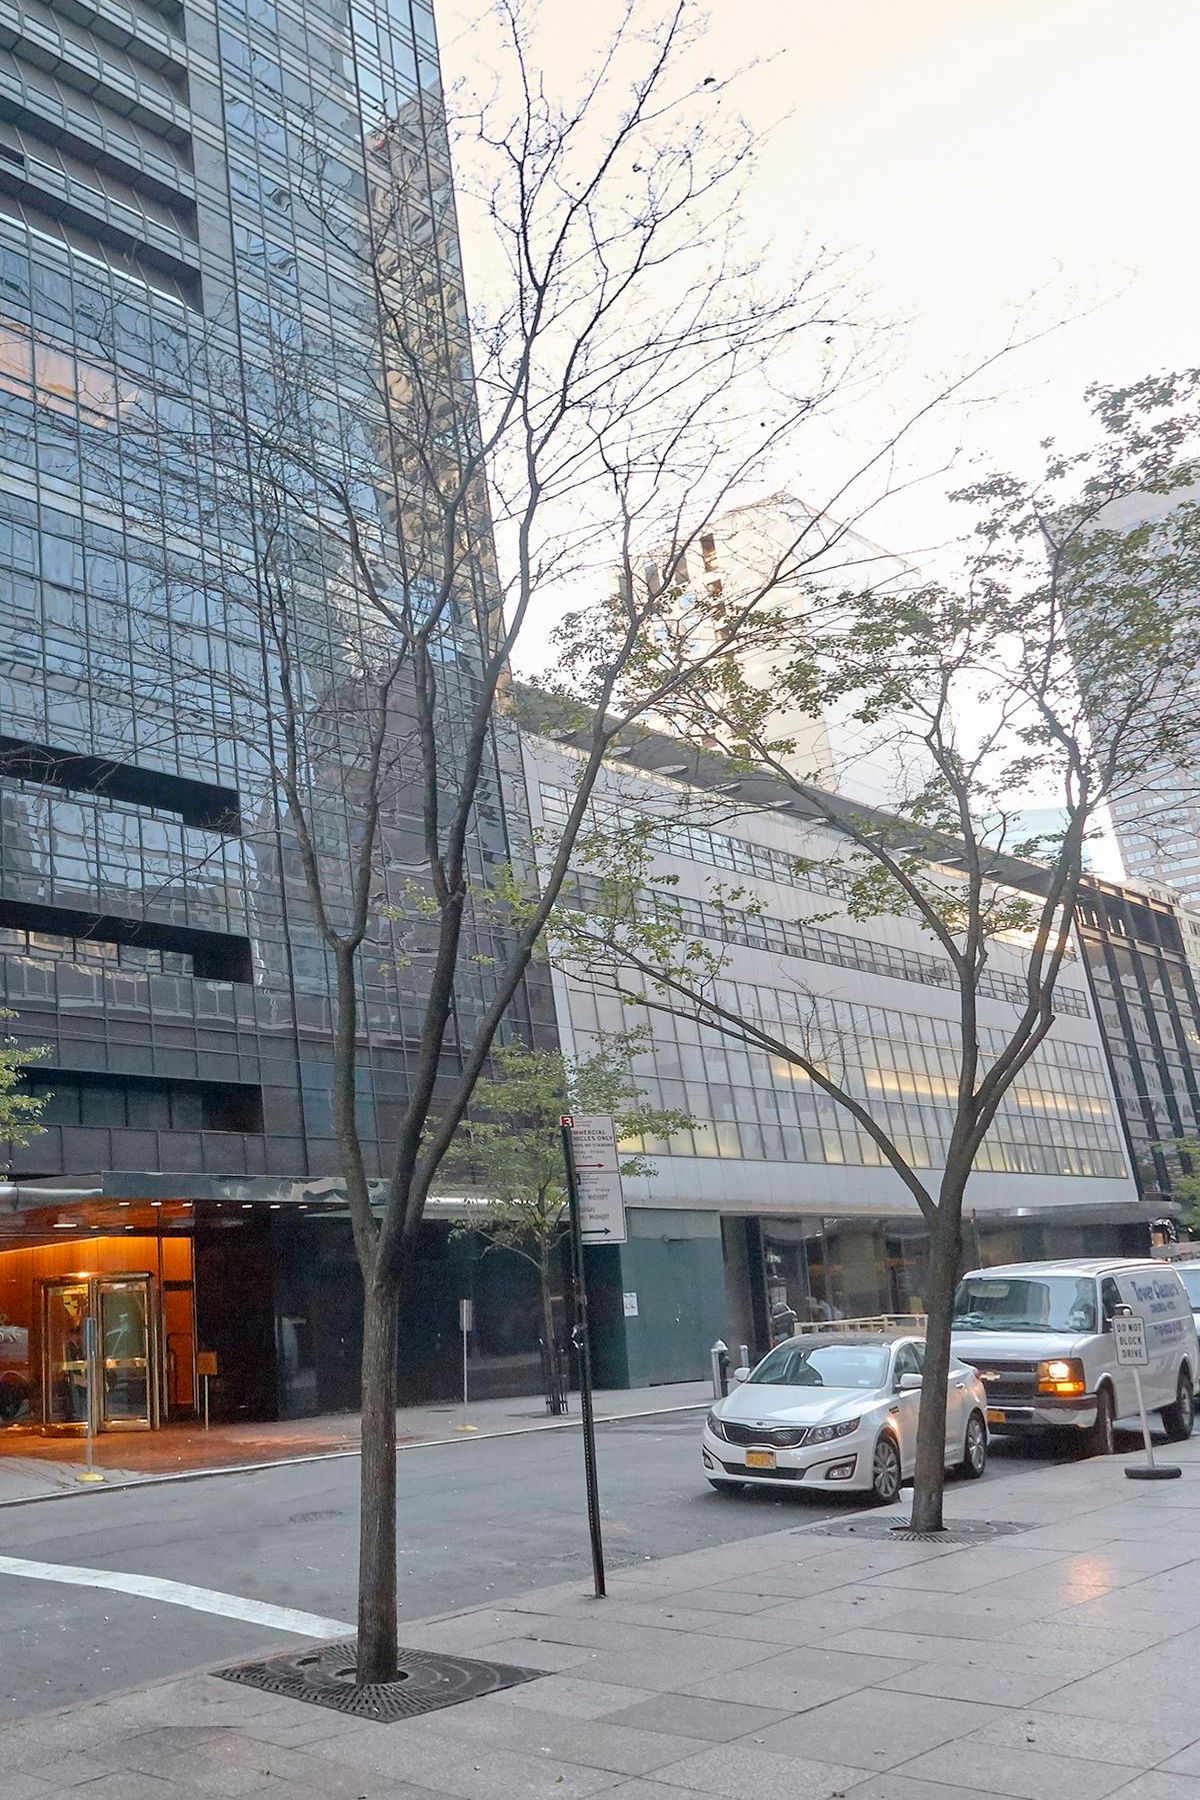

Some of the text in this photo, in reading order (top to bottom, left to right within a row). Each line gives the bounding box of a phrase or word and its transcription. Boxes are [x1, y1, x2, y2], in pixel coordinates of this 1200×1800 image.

[563, 1117, 572, 1126] 3
[1116, 1323, 1142, 1333] DO NOT
[1119, 1337, 1142, 1346] BLOCK
[1121, 1349, 1143, 1358] DRIVE
